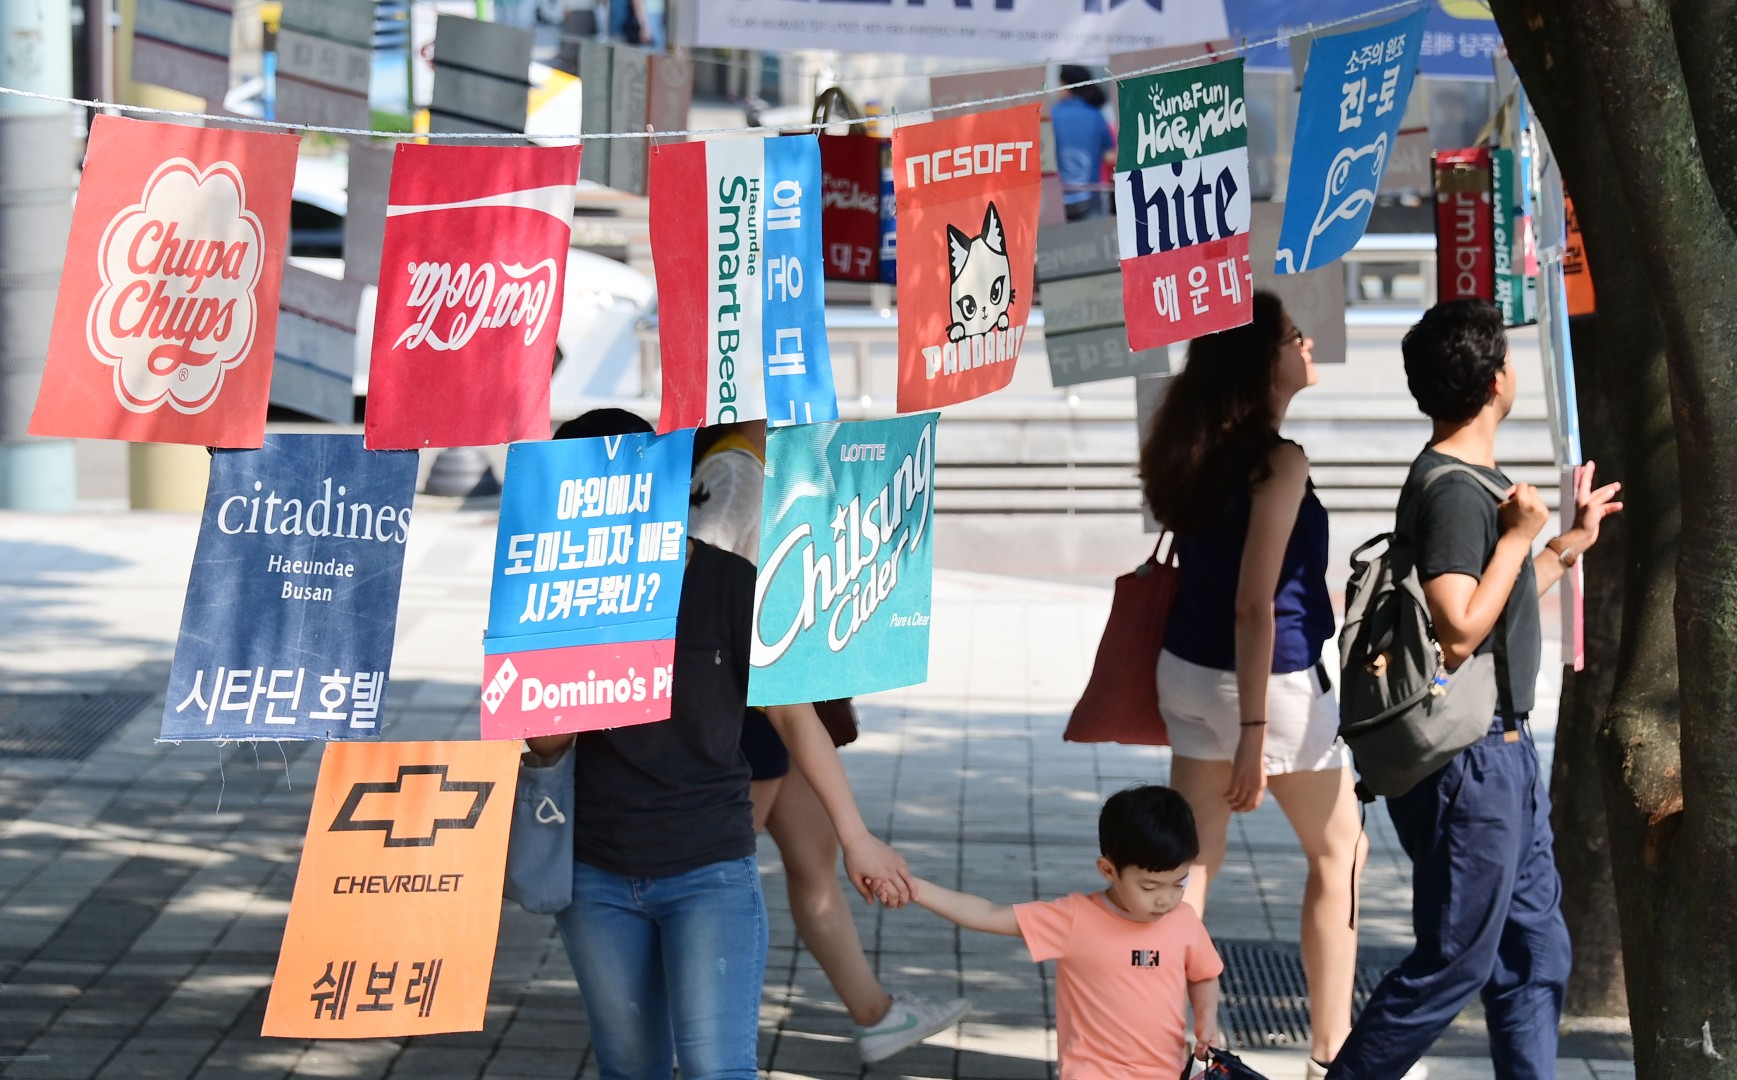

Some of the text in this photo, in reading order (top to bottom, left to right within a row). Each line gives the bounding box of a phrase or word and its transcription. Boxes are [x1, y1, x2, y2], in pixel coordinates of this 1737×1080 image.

[1344, 33, 1407, 75] 소주의 원조
[1151, 81, 1224, 120] Sun&Fun
[905, 141, 1033, 189] NCSOFT
[747, 178, 760, 277] Haeundae
[1126, 160, 1238, 257] hite
[127, 219, 249, 294] Chupa
[718, 175, 747, 323] Smart
[109, 279, 238, 377] Chups
[391, 257, 558, 351] Coca-Cola
[921, 324, 1024, 380] PANDAKAT
[840, 443, 886, 462] LOTTE
[217, 477, 413, 544] citadines
[556, 473, 653, 520] 야외에서
[267, 554, 355, 578] Haeundae
[504, 520, 684, 576] 도미노피자 배달
[749, 422, 931, 668] Chilsung
[281, 581, 333, 602] Busan
[826, 527, 910, 652] Cider
[890, 612, 907, 627] Pure
[911, 611, 930, 627] Clear
[175, 666, 385, 729] 시타딘 호텔
[521, 666, 647, 712] Domino's
[333, 873, 464, 894] CHEVROLET
[310, 958, 443, 1020] 쉐보레
